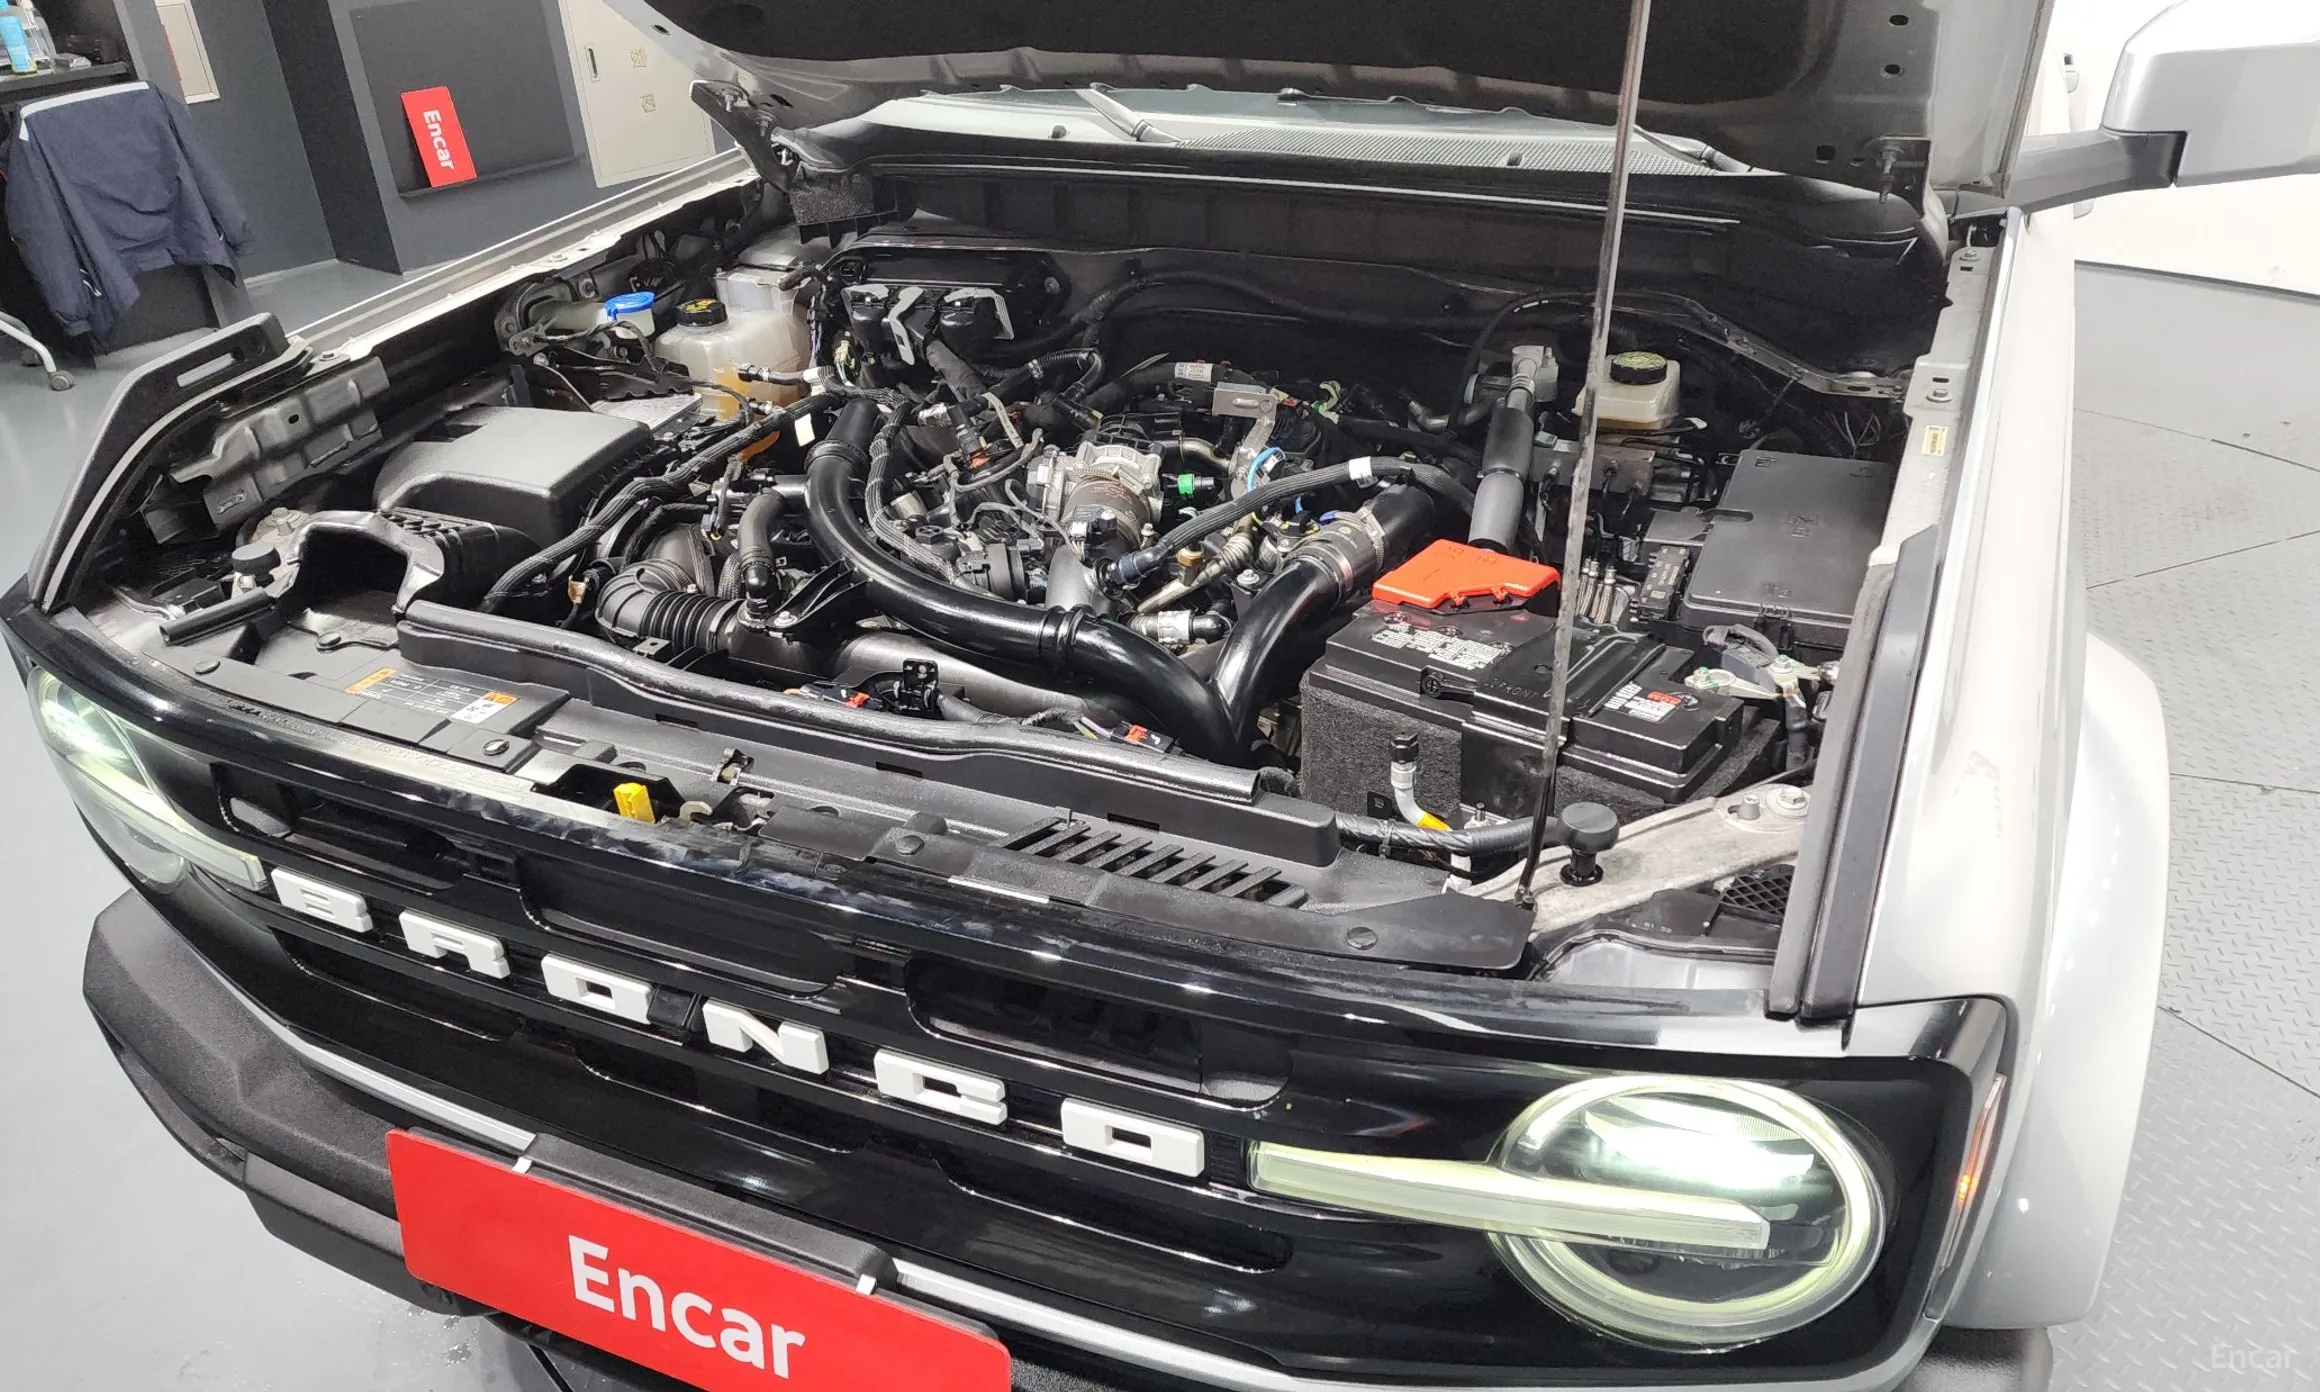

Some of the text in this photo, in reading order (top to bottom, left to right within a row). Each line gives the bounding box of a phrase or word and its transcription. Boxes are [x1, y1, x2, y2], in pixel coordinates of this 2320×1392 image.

[423, 109, 455, 170] Encar
[271, 868, 1205, 1178] BRONCO
[568, 1234, 806, 1380] Encar
